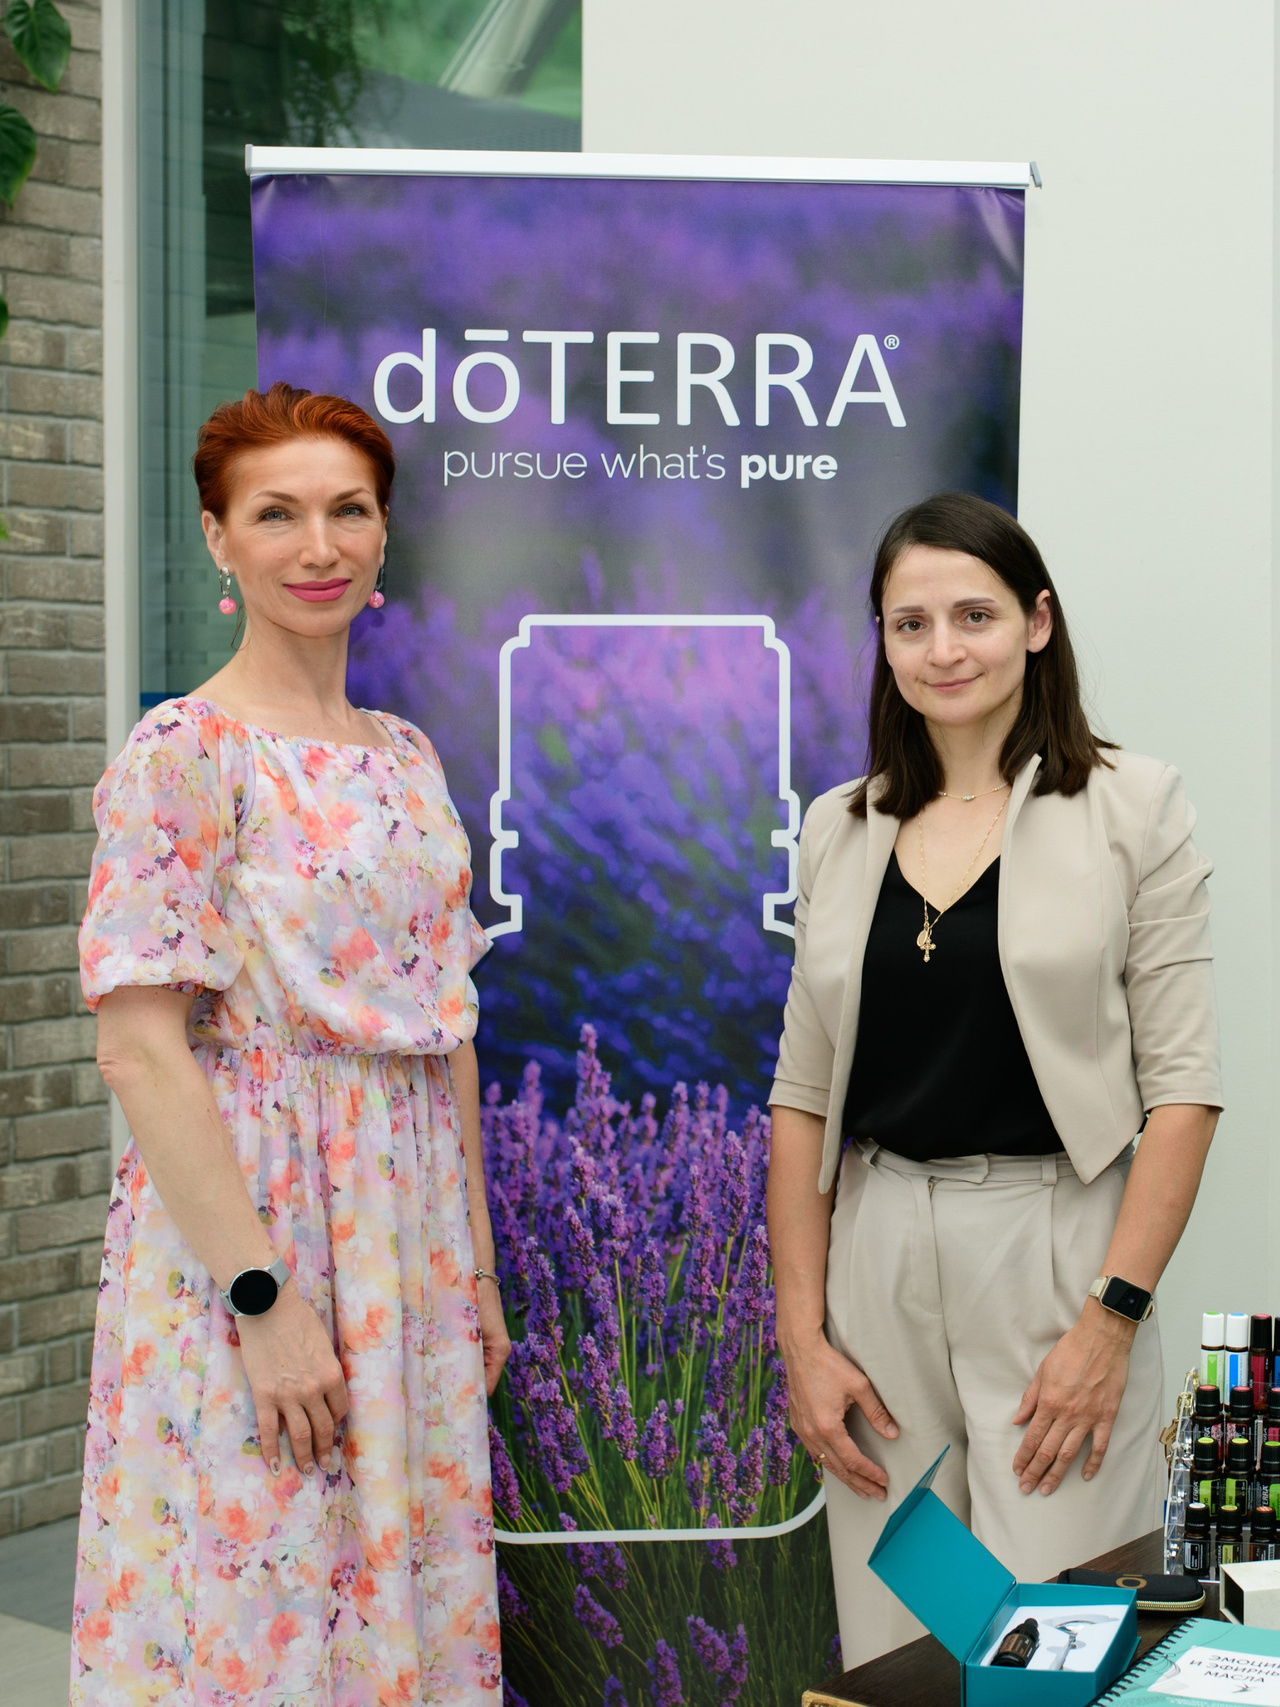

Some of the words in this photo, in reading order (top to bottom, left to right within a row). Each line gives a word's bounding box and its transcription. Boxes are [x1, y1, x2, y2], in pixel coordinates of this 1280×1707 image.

[443, 449, 588, 487] pursue
[600, 444, 726, 480] what's
[740, 453, 838, 489] pure
[1204, 1670, 1266, 1683] МАСЛА
